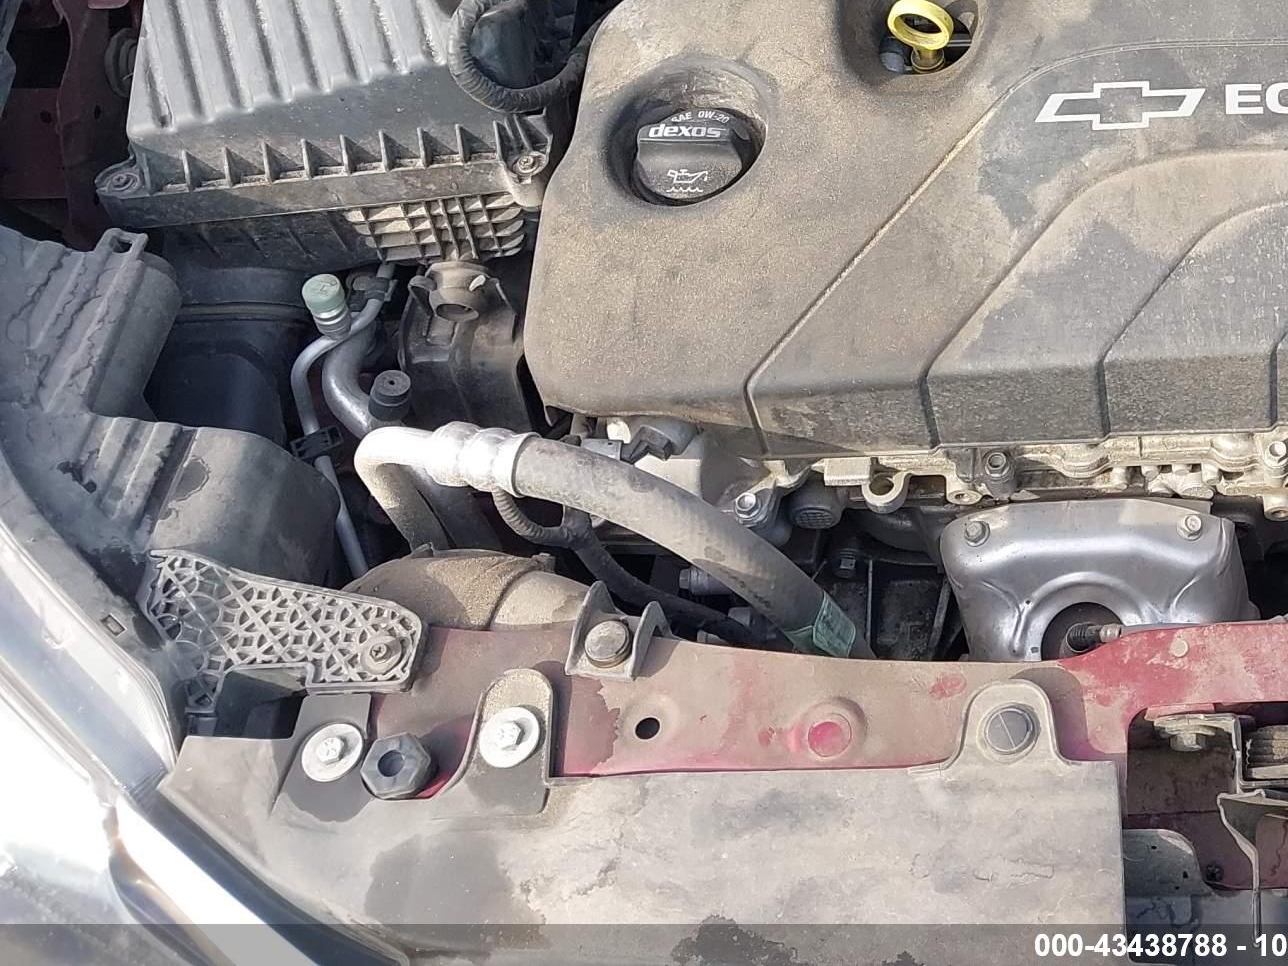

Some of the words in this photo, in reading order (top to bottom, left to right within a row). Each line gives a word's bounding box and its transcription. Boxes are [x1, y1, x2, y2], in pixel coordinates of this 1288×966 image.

[671, 111, 692, 122] SAE
[697, 110, 730, 123] 0W-20
[649, 124, 725, 138] dexos
